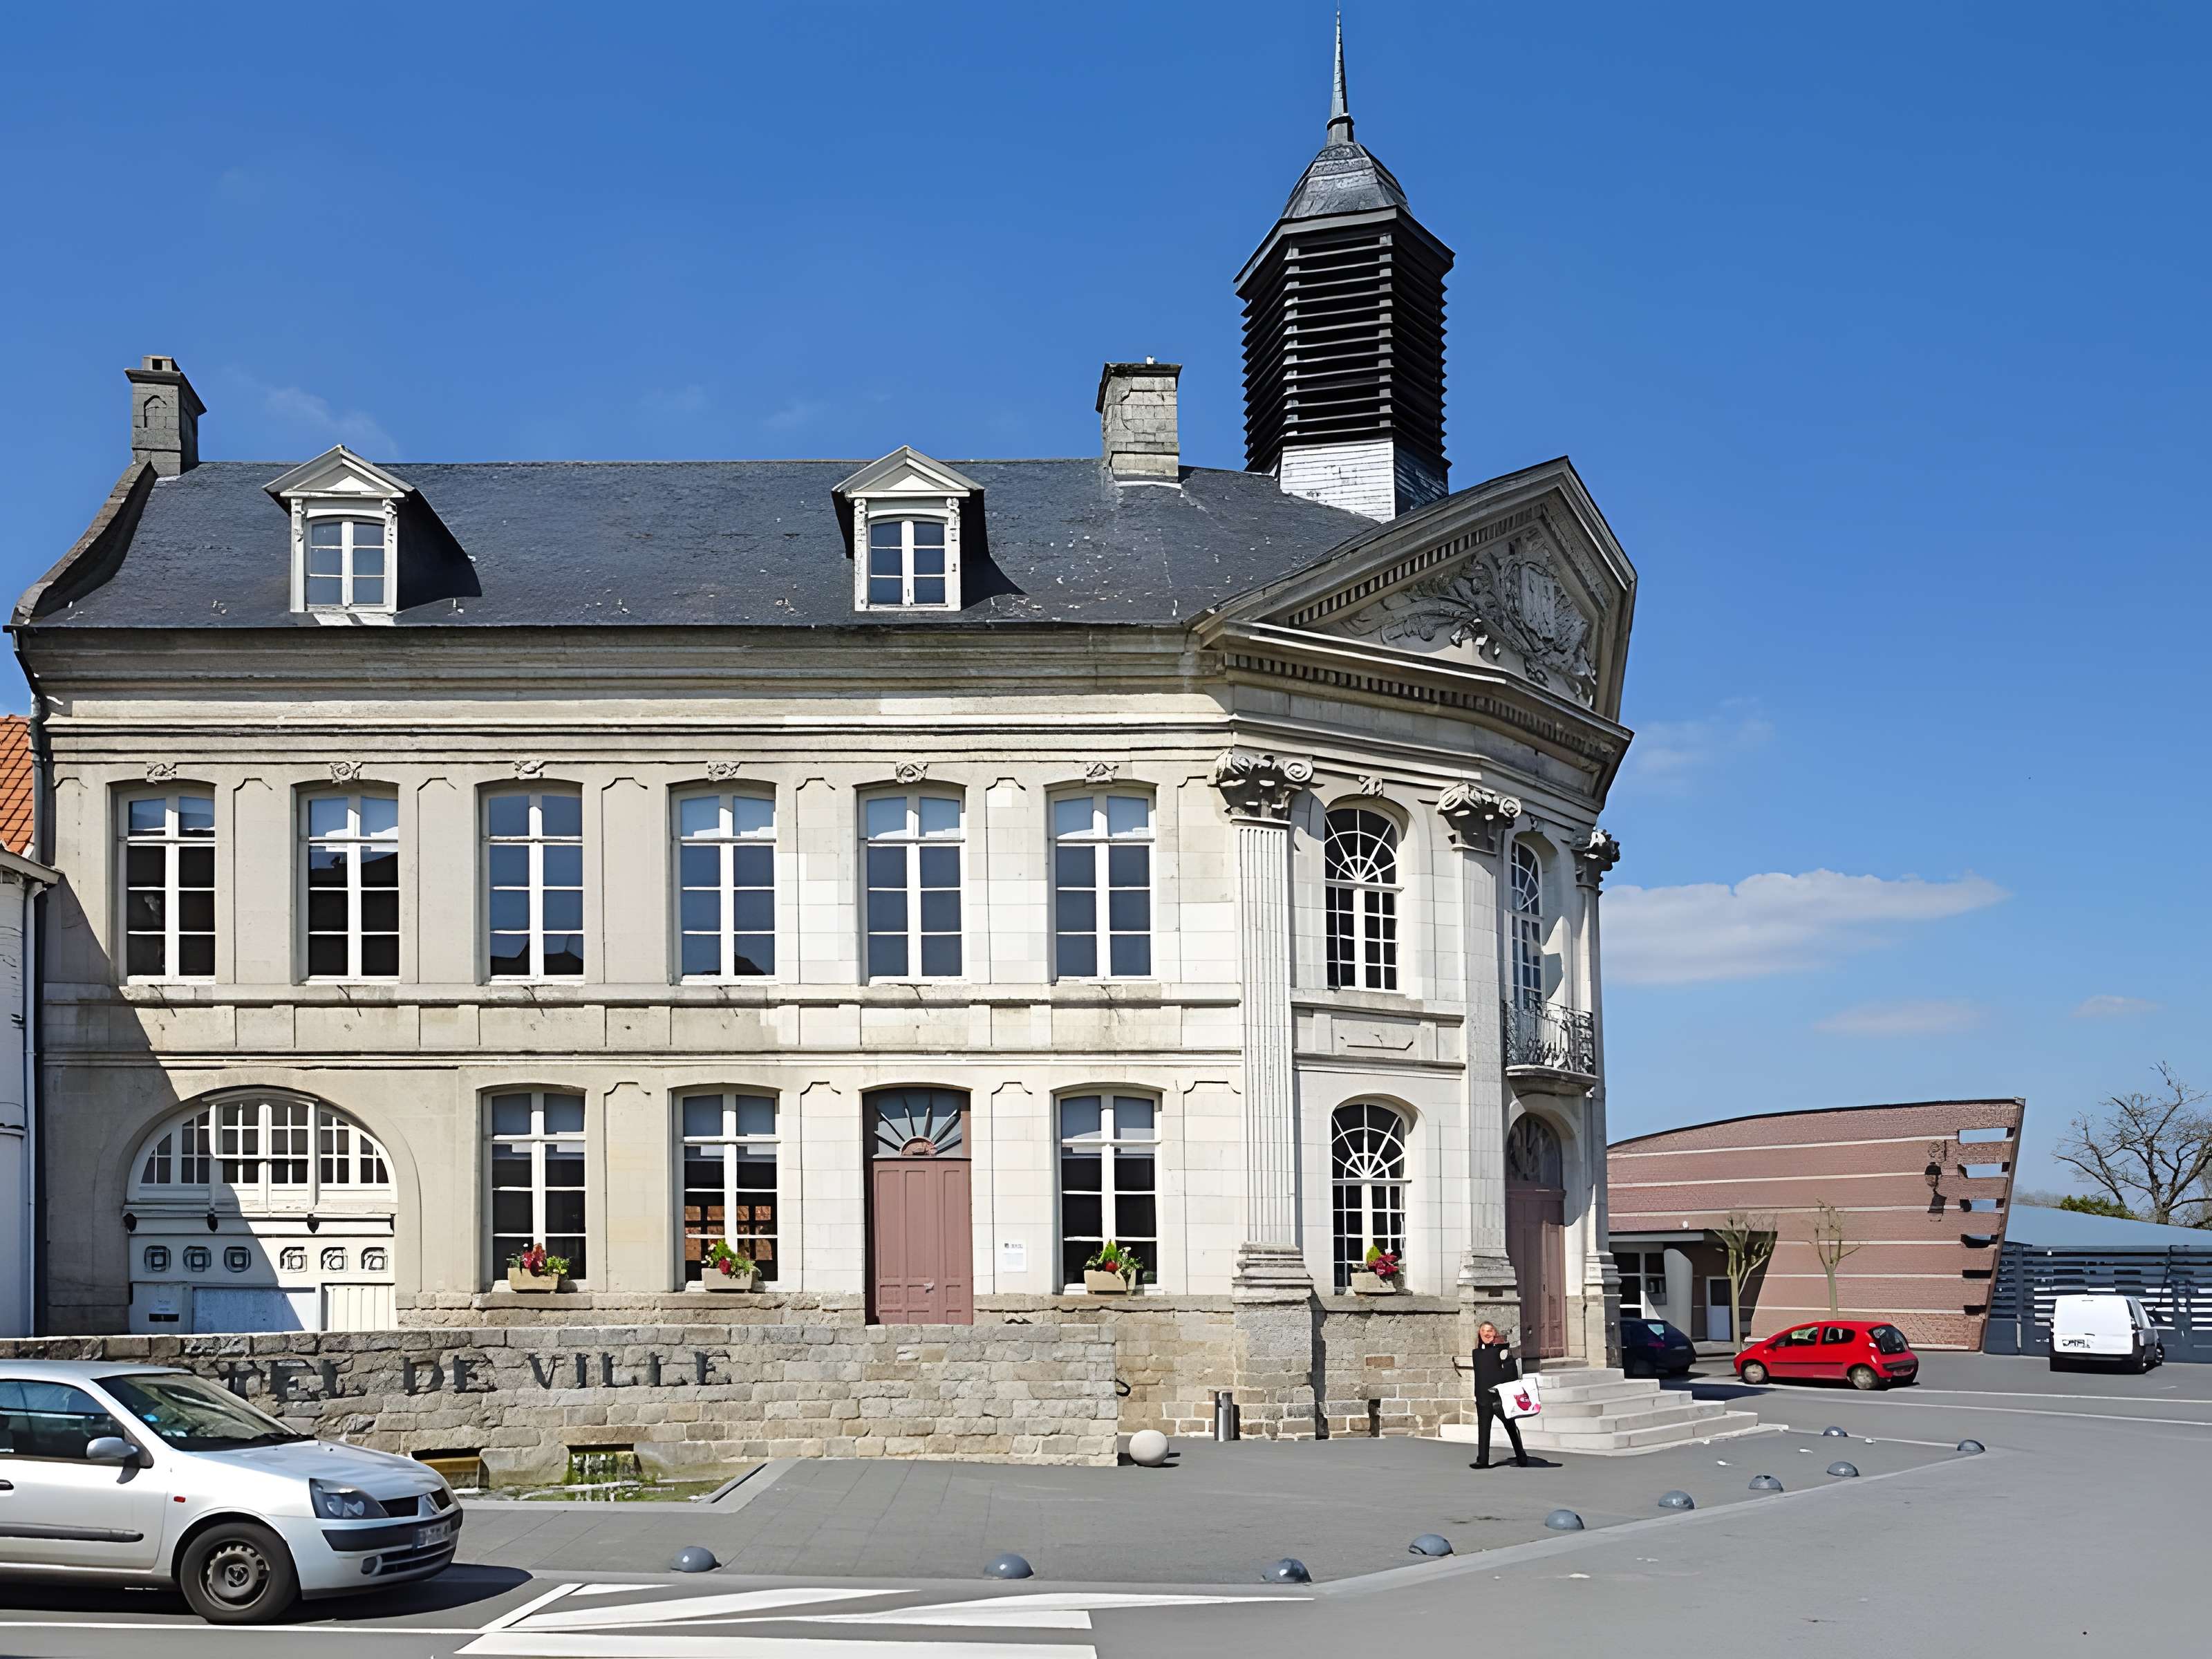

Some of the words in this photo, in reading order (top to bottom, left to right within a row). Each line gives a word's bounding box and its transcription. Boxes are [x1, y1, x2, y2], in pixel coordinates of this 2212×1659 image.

[218, 1359, 367, 1403] TEL
[403, 1354, 498, 1396] DE
[525, 1351, 731, 1390] VILLE
